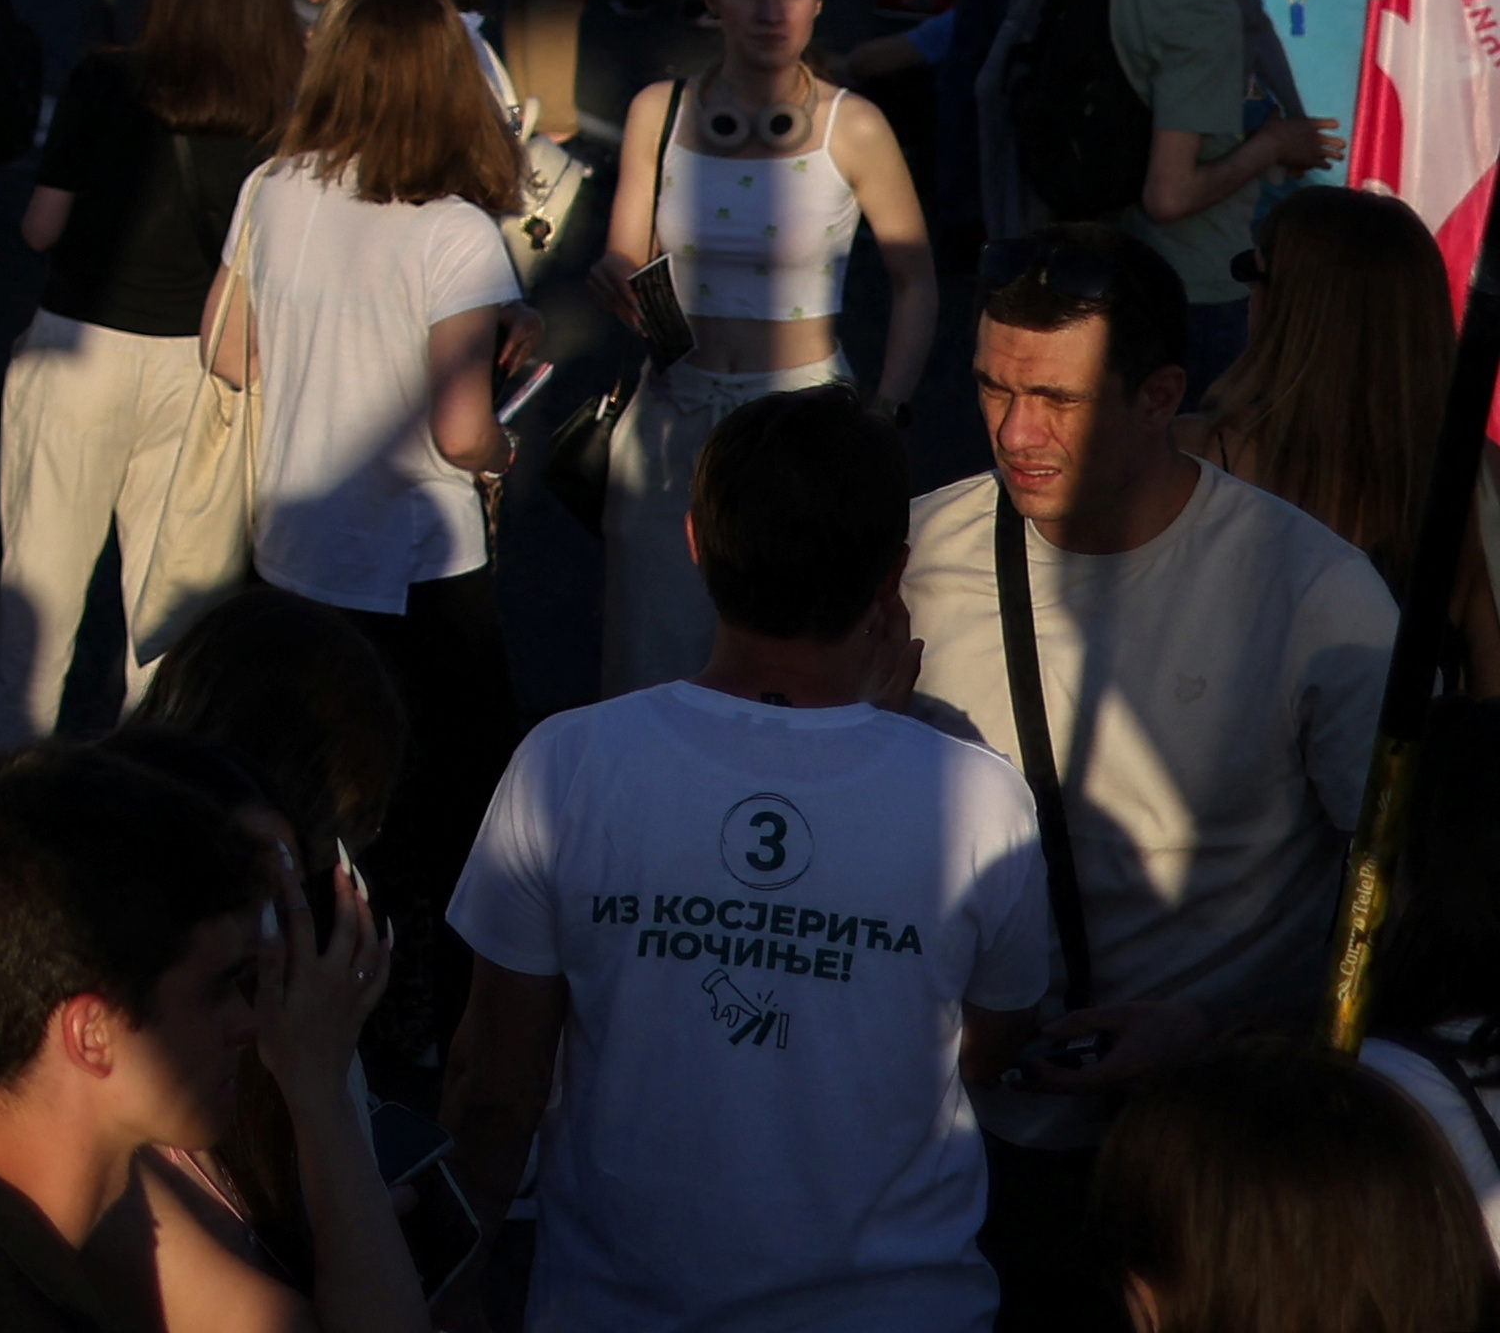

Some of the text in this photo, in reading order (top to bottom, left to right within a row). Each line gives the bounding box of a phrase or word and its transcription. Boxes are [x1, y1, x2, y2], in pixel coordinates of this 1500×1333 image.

[746, 811, 788, 872] 3
[591, 895, 924, 955] ИЗ КОСЈЕРИЋА
[637, 929, 854, 983] ПОЧИЊЕ!
